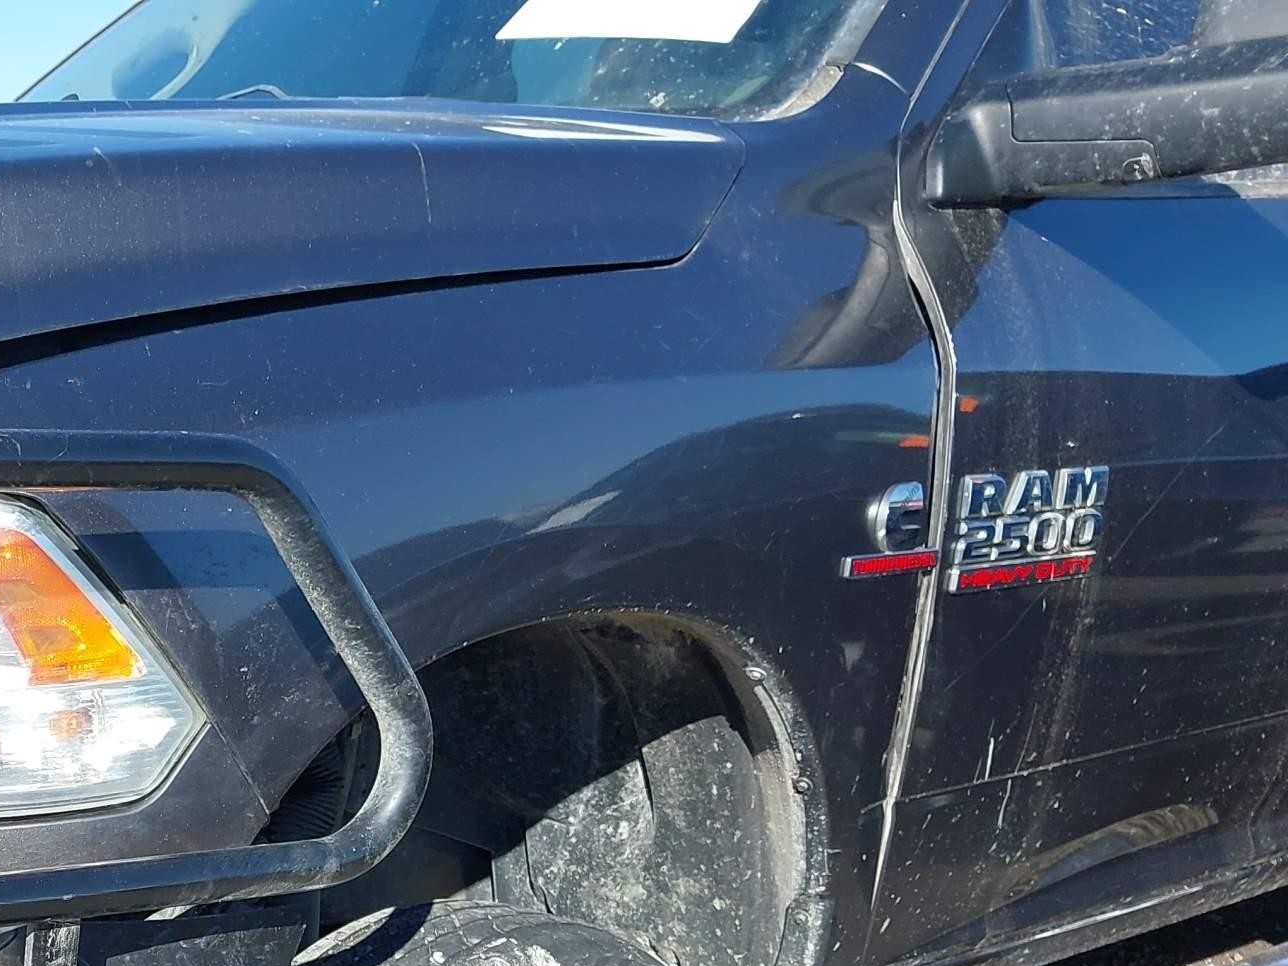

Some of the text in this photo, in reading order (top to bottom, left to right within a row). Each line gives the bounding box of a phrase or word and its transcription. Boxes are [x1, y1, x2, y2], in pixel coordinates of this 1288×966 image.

[960, 466, 1109, 518] RAM
[955, 510, 1103, 559] 2500
[960, 564, 1033, 588] HEAVY
[1035, 557, 1093, 579] DUTY
